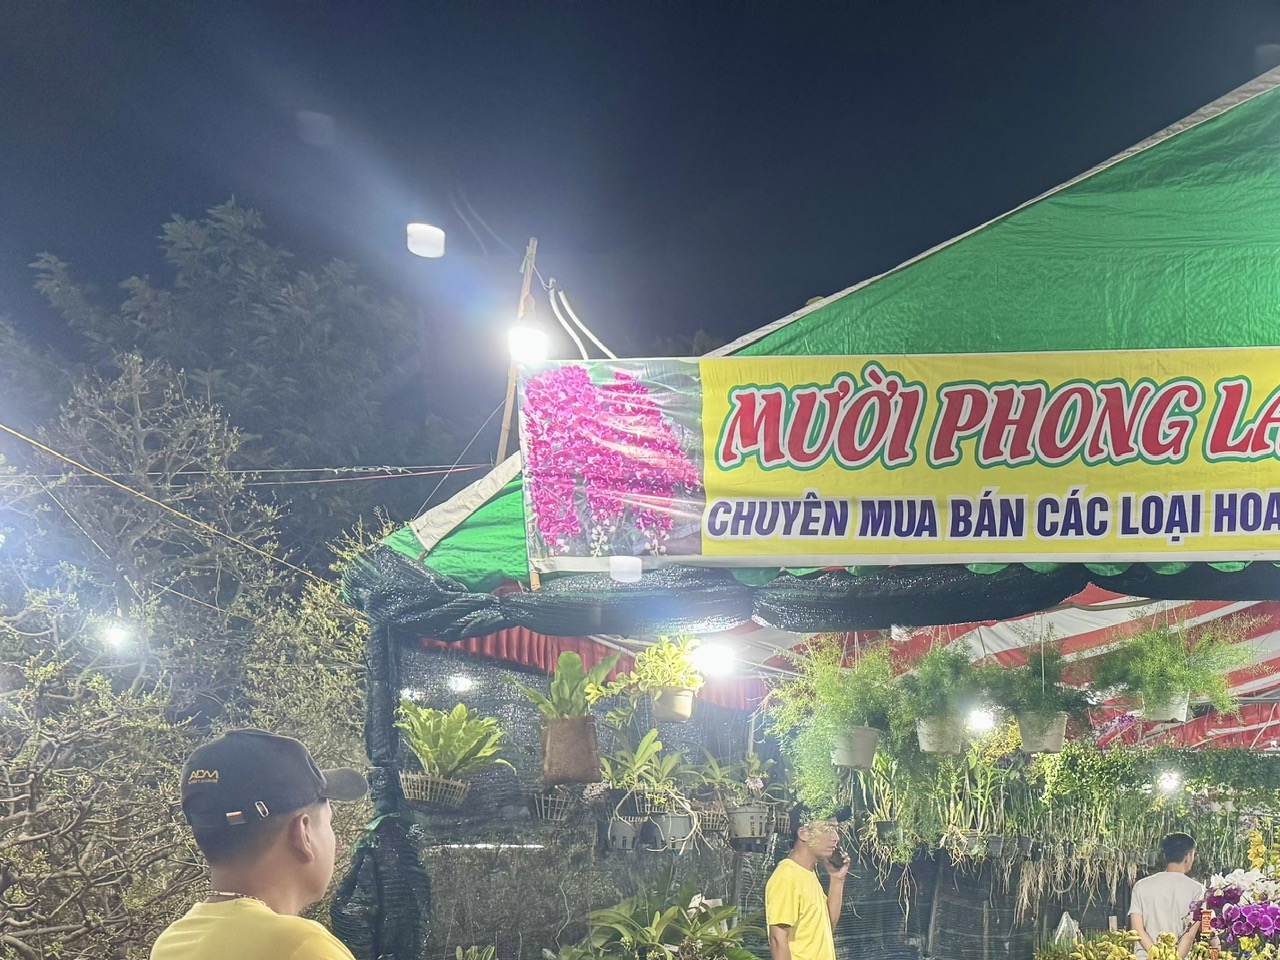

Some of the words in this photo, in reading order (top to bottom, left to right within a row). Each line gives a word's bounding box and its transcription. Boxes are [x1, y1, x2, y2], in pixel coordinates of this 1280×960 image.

[718, 364, 924, 468] MƯỜI
[930, 380, 1202, 466] PHONG
[706, 491, 849, 537] CHUYÊN
[858, 499, 939, 538] MUA
[950, 490, 1025, 538] BÁN
[1037, 488, 1109, 537] CÁC
[1120, 493, 1201, 542] LOẠI
